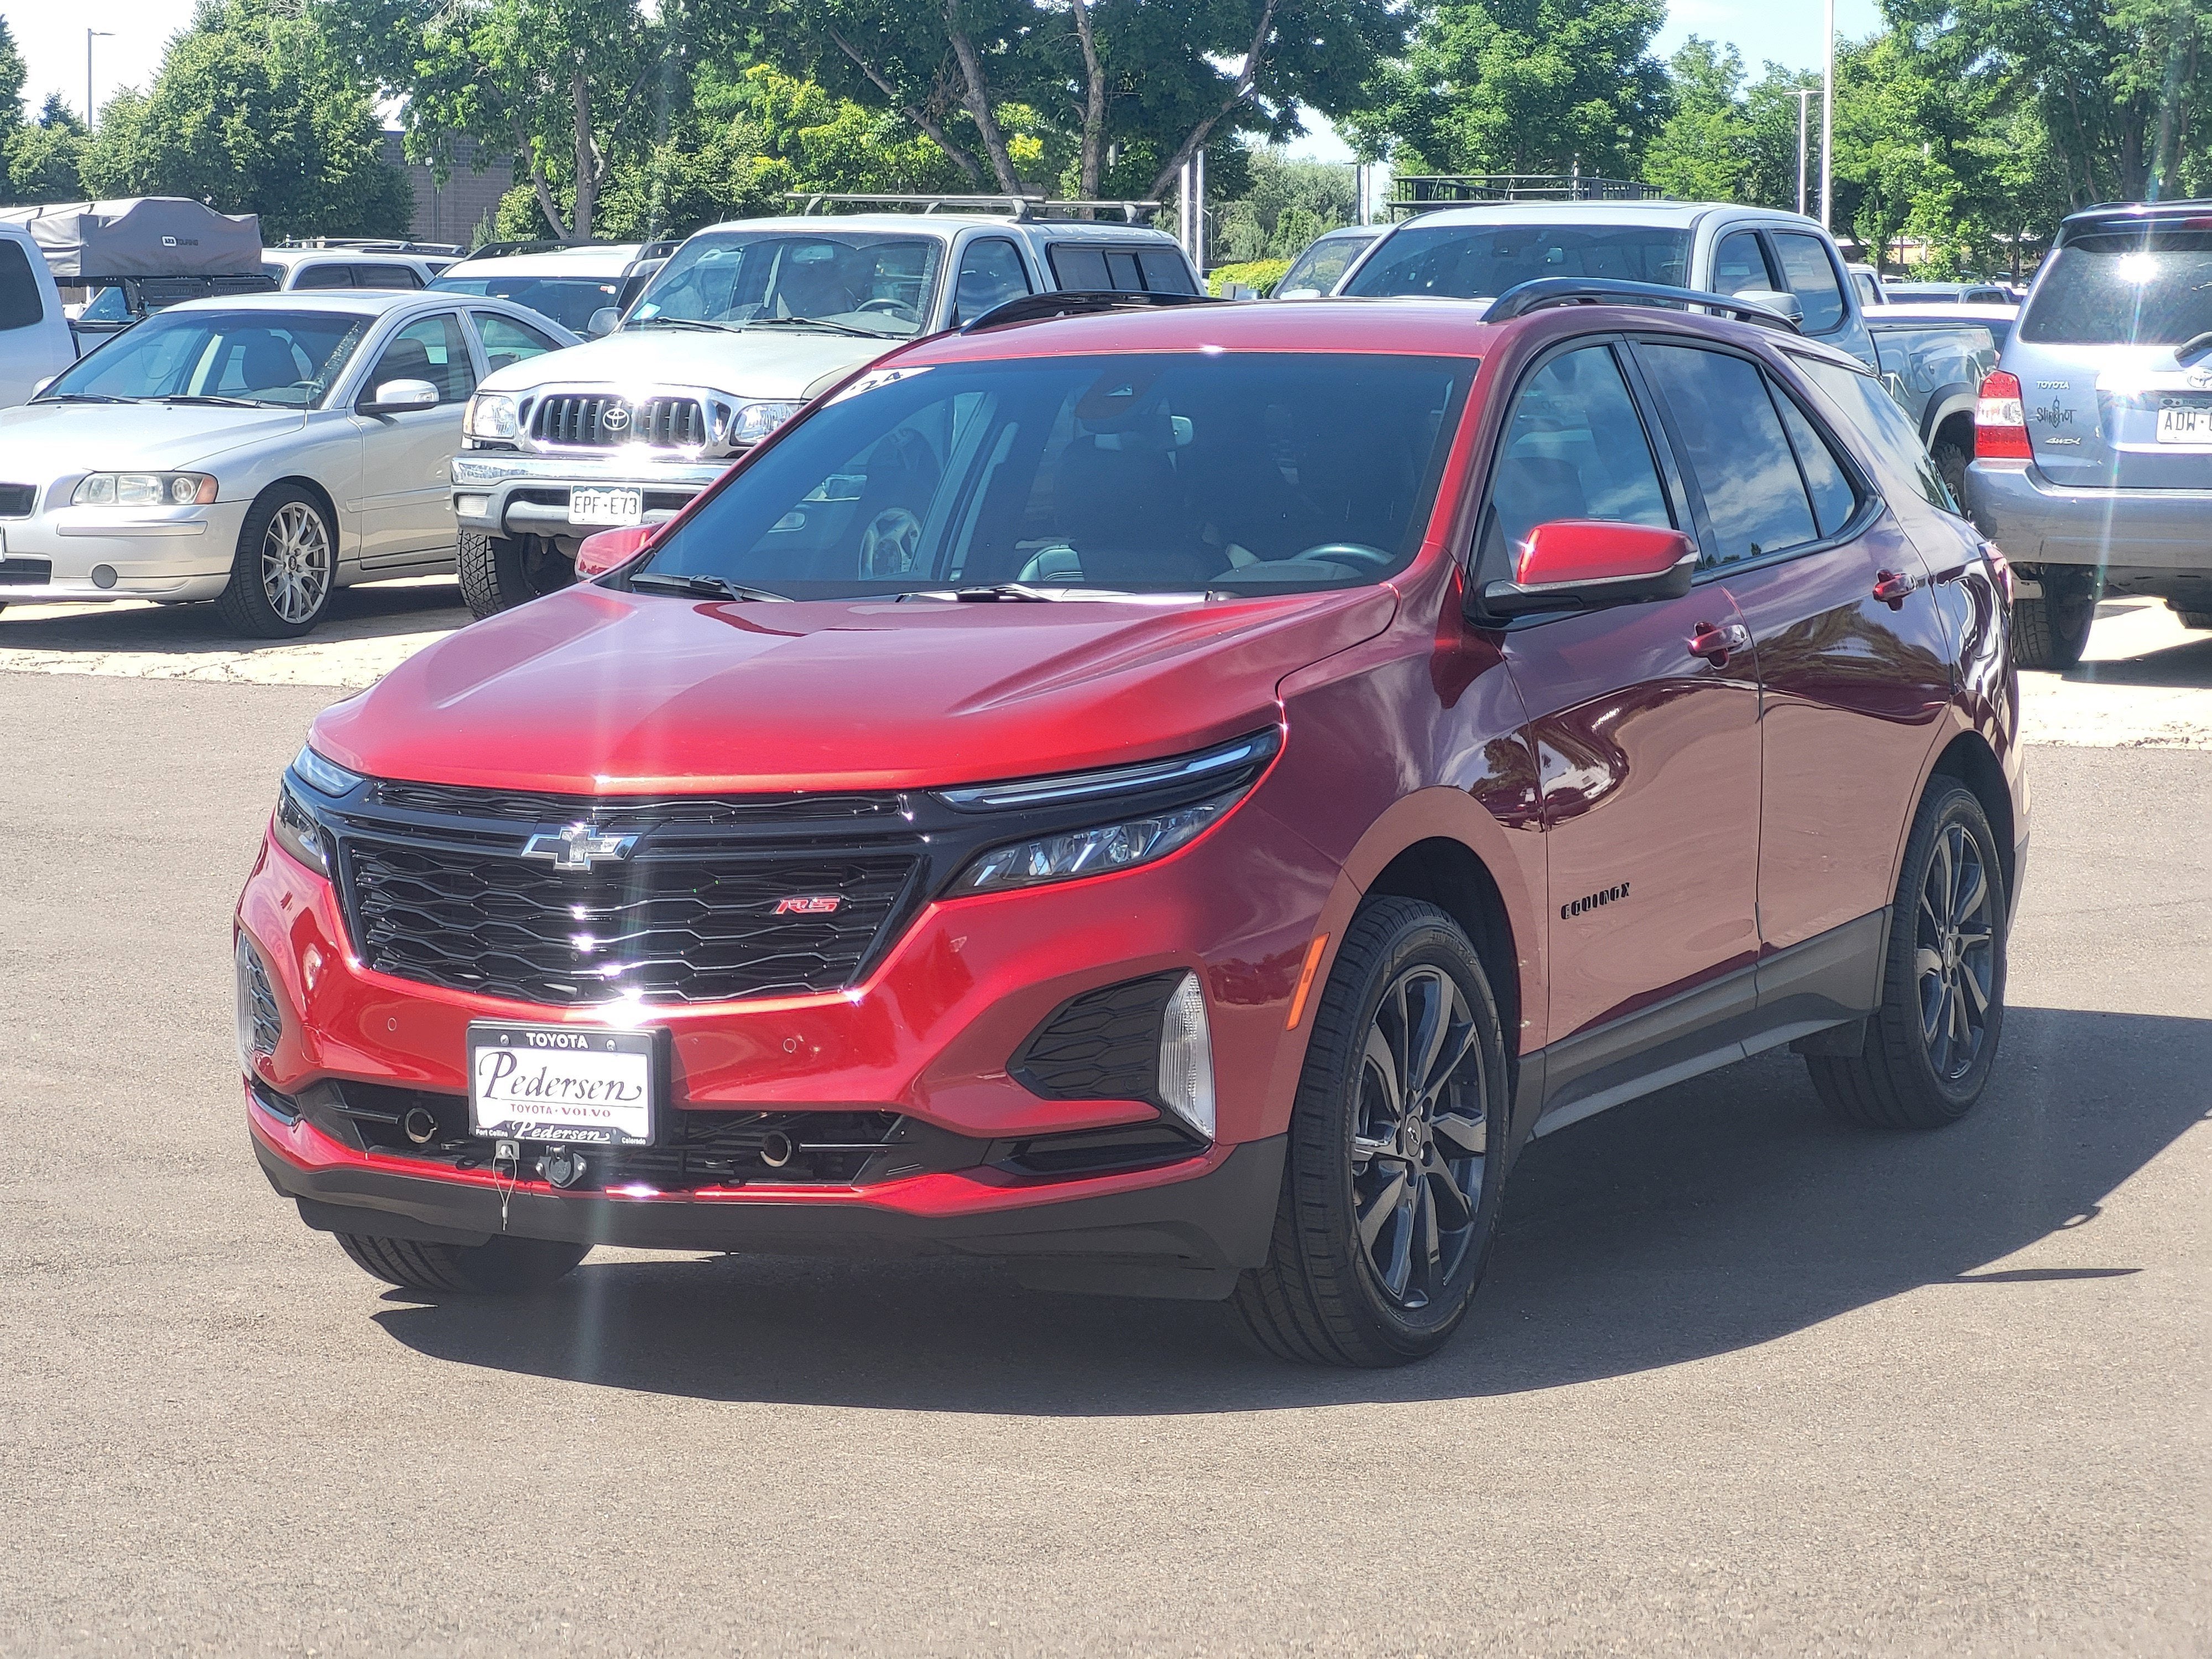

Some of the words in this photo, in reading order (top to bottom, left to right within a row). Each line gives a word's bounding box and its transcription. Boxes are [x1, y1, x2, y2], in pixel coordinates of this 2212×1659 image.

[2036, 380, 2070, 390] TOYOTA
[772, 895, 841, 915] RS
[1561, 882, 1630, 920] EQUINOX
[526, 1032, 589, 1049] TOYOTA
[479, 1051, 642, 1101] Pedersen
[510, 1103, 552, 1115] TOYOTA
[561, 1107, 611, 1118] VOLVO
[512, 1120, 611, 1142] Pedersen
